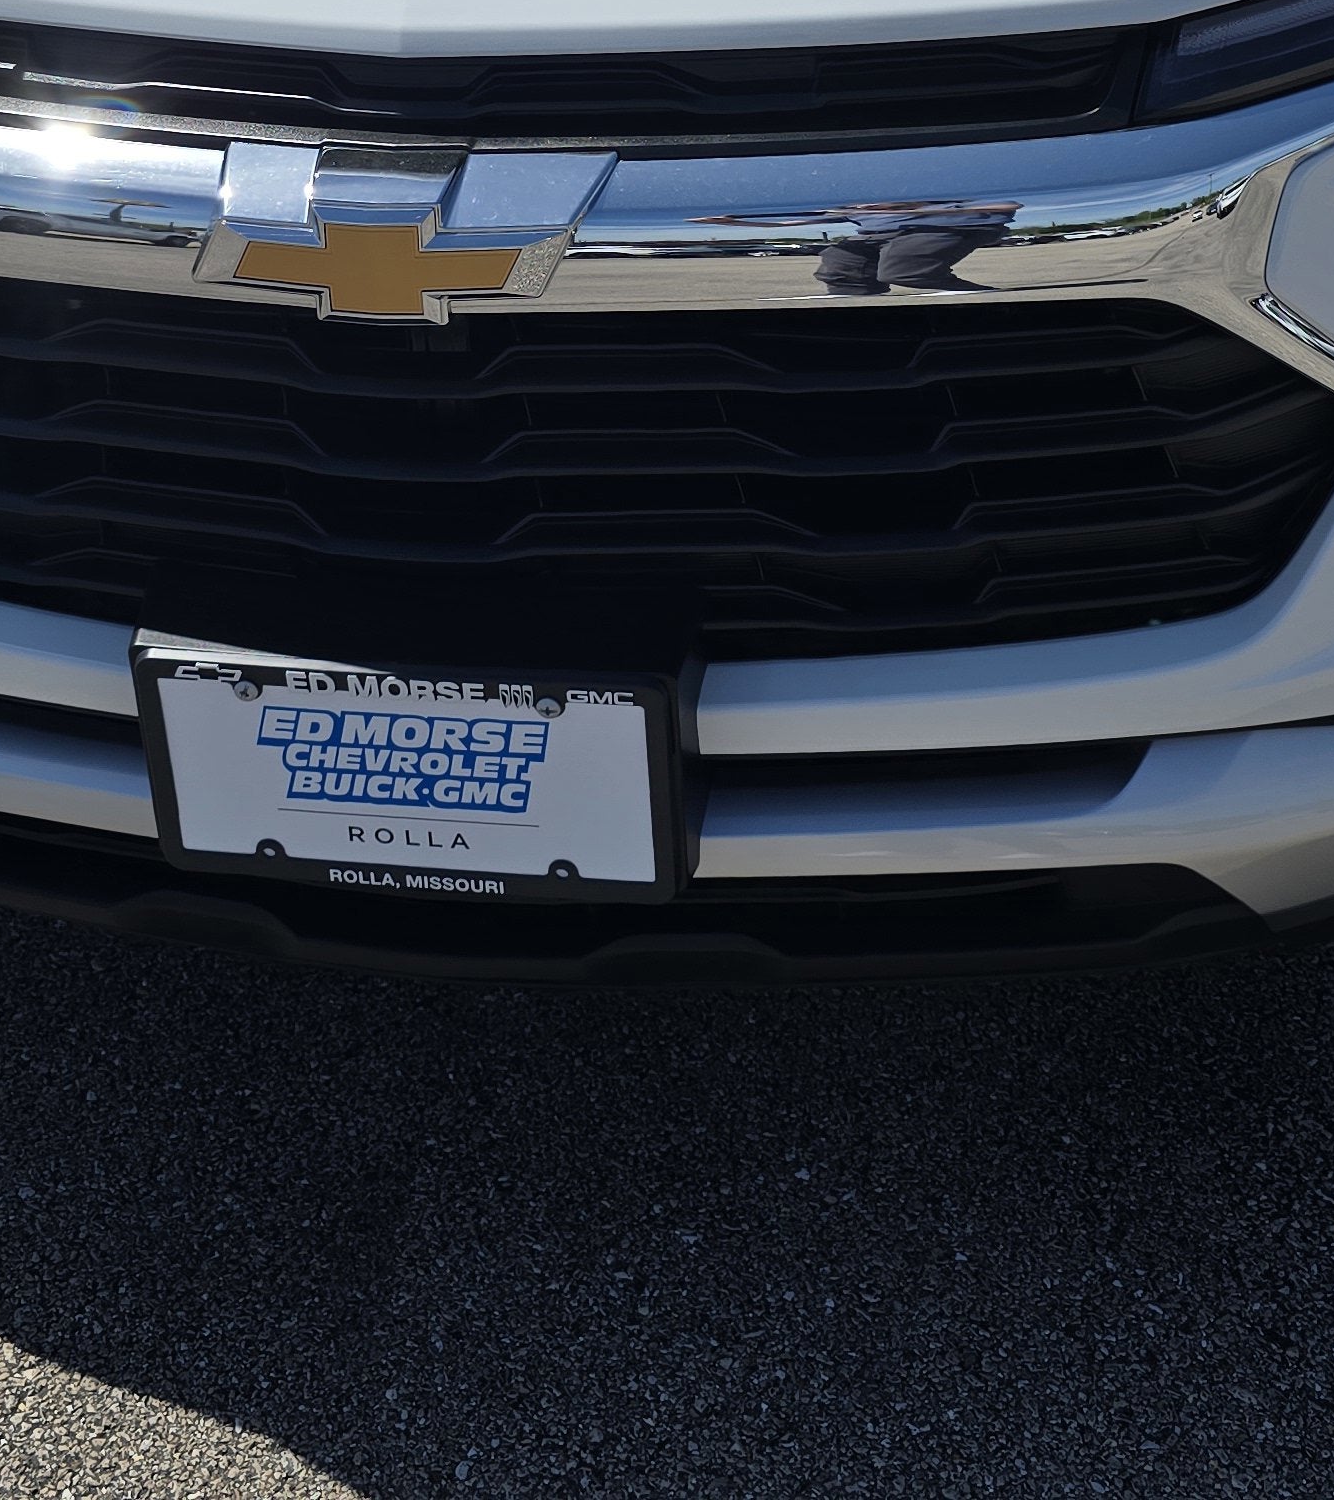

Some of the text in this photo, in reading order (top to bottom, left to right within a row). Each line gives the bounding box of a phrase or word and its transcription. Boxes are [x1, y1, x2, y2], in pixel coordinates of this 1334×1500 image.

[284, 670, 634, 707] ED MORSE GMC
[261, 707, 546, 754] ED MORSE
[284, 742, 527, 781] CHEVROLET
[348, 825, 471, 851] ROLLA
[329, 868, 506, 896] ROLLA, MISSOURI
